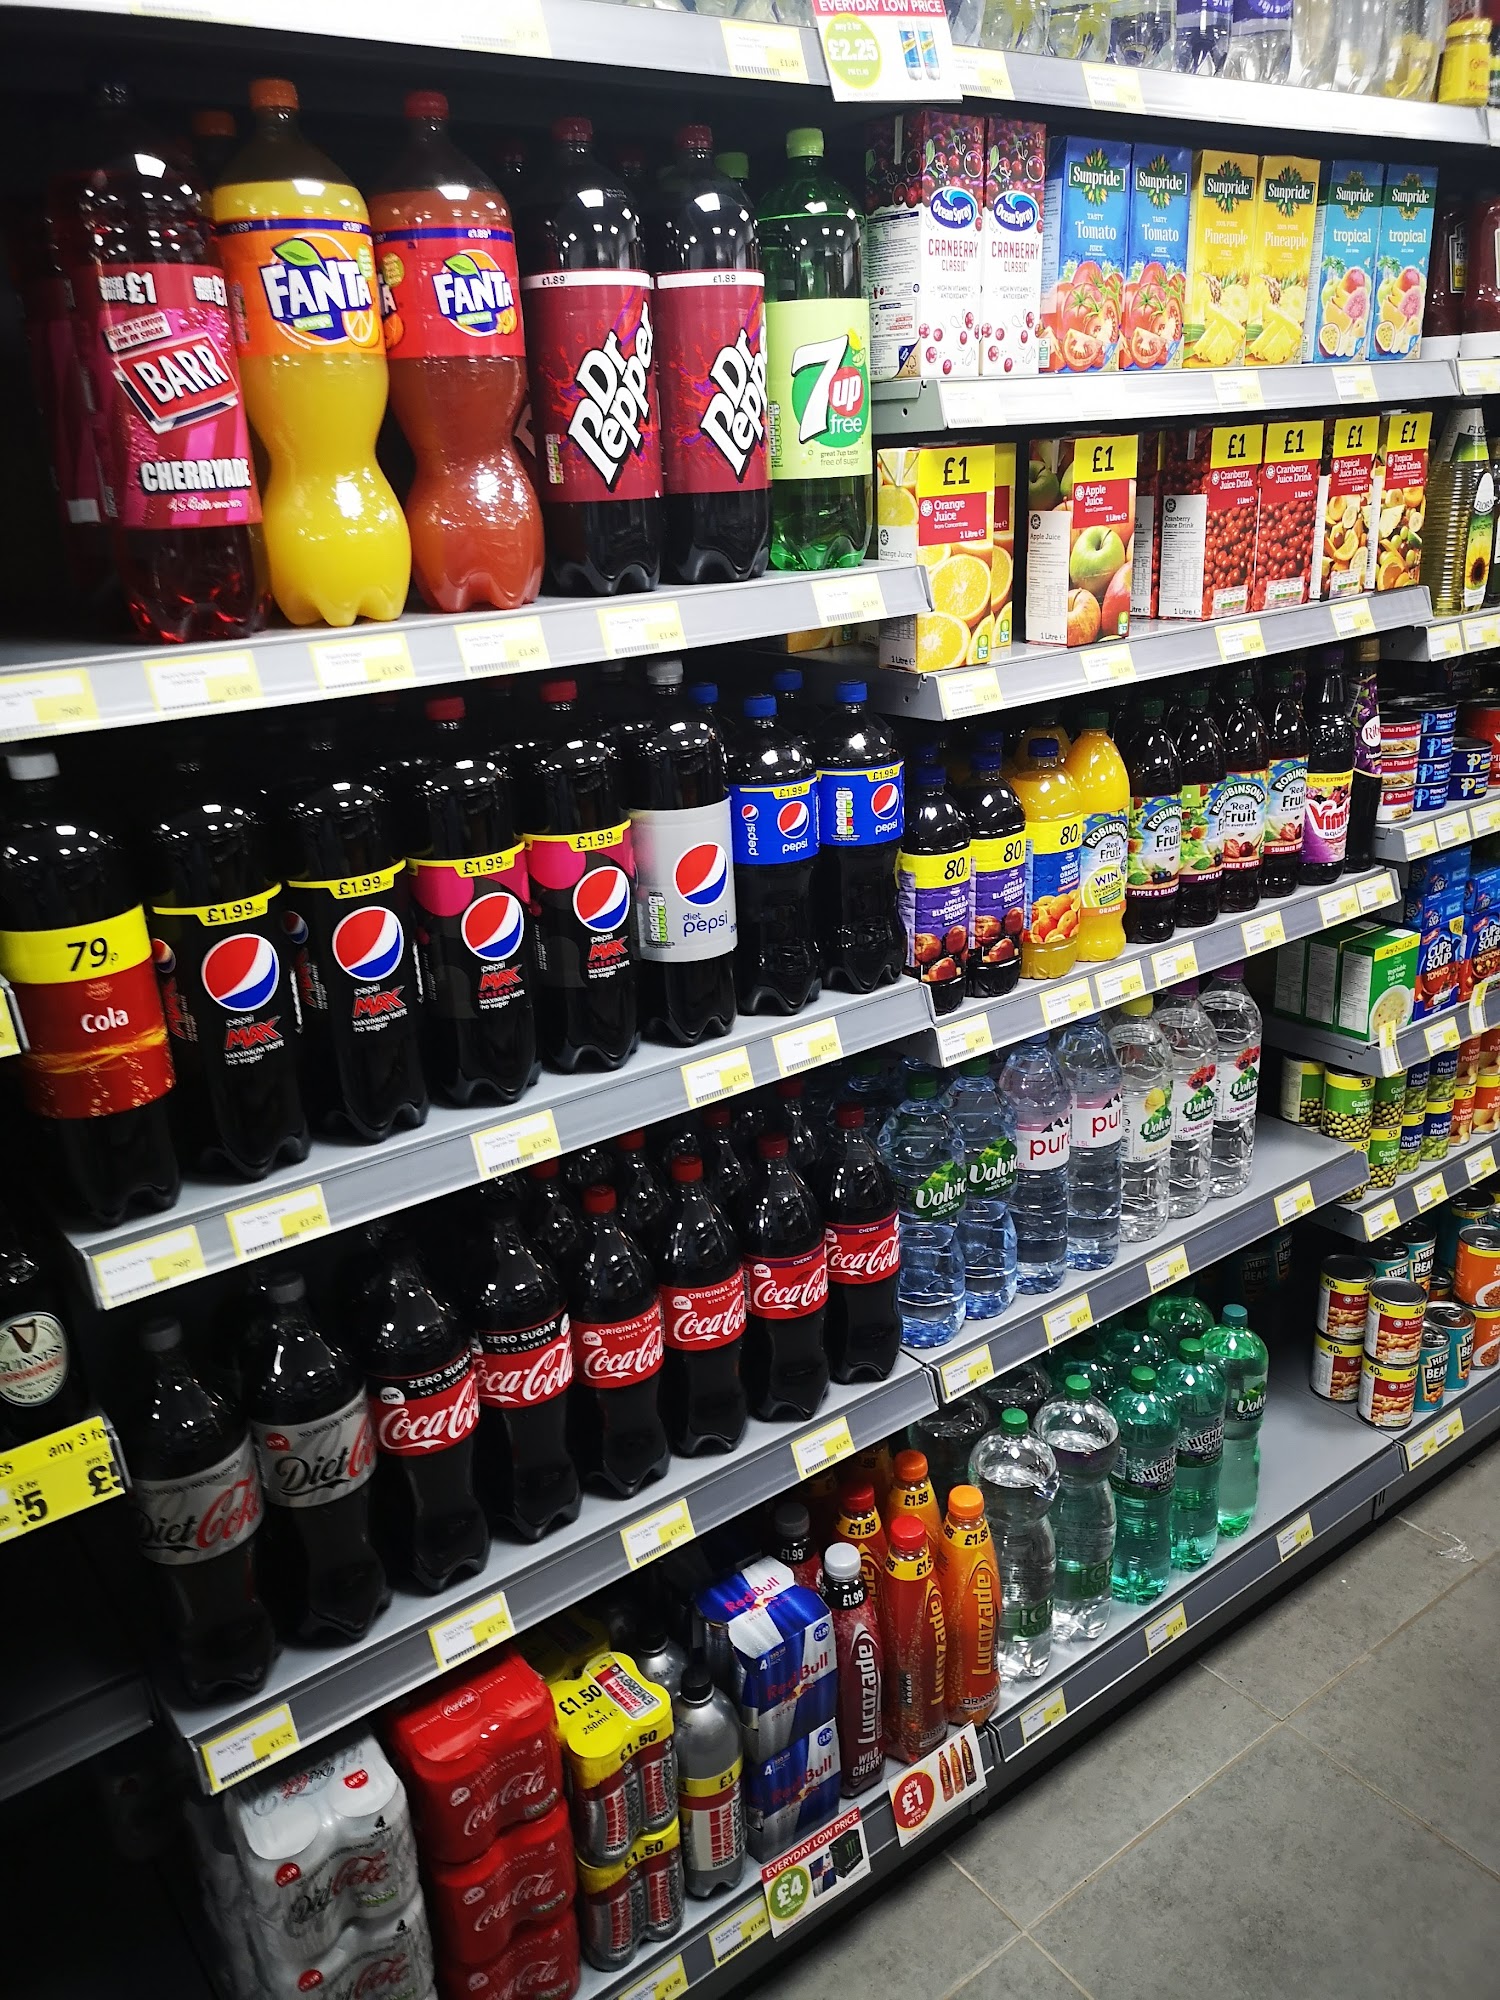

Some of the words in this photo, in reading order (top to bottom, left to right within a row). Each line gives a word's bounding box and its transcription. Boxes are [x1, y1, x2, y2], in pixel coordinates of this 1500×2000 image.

[819, 0, 879, 12] EVERYDAY
[883, 0, 908, 12] LOW
[912, 0, 943, 13] PRICE
[827, 38, 878, 61] £2.25
[1072, 166, 1121, 189] Sunpride
[1139, 171, 1182, 191] Sunpride
[1206, 178, 1250, 199] Sunpride
[1267, 184, 1311, 204] Sunpride
[1335, 186, 1374, 204] Sunpride
[1391, 187, 1430, 205] Sunpride
[933, 199, 954, 222] Ocean
[953, 204, 974, 223] Spray
[995, 203, 1016, 224] Ocean
[1015, 207, 1034, 225] Spray
[1087, 212, 1104, 221] TASTY
[1074, 219, 1117, 240] Tomato
[1141, 223, 1180, 242] Tomato
[1204, 229, 1249, 246] Pineapple
[1333, 229, 1371, 243] tropical
[1389, 228, 1427, 244] tropical
[928, 238, 978, 259] CRANBERRY
[991, 240, 1039, 260] CRANBERRY
[1264, 232, 1309, 249] Pineapple
[941, 259, 966, 273] CLASSIC
[1004, 260, 1029, 273] CLASSIC
[125, 271, 157, 304] £1
[541, 274, 566, 286] £1.89
[712, 274, 737, 284] £1.89
[261, 261, 373, 318] FANTA
[435, 271, 514, 315] FANTA
[133, 344, 229, 404] BARR
[576, 331, 628, 416] Dr
[710, 328, 757, 410] Dr
[568, 301, 653, 486] Pepper
[829, 415, 862, 435] free
[1400, 420, 1417, 444] £1
[1227, 432, 1247, 459] £1
[1284, 428, 1305, 454] £1
[1347, 424, 1363, 449] £1
[820, 458, 834, 467] free
[835, 457, 843, 465] of
[843, 456, 860, 467] sugar
[1092, 445, 1115, 473] £1
[1339, 459, 1360, 471] Tropical
[1394, 453, 1414, 465] Tropical
[1394, 462, 1408, 472] Juice
[1407, 460, 1422, 470] Drink
[139, 459, 252, 492] CHERRYADE
[942, 456, 971, 486] £1
[1220, 470, 1250, 483] Cranberry
[1275, 463, 1309, 476] Cranberry
[1275, 473, 1293, 485] Juice
[1293, 471, 1313, 483] Drink
[1339, 468, 1353, 478] Juice
[1353, 466, 1368, 476] Drink
[1085, 484, 1107, 496] Apple
[1219, 479, 1235, 490] Juice
[1236, 477, 1253, 488] Drink
[933, 499, 965, 511] Orange
[1084, 496, 1104, 506] Juice
[1475, 499, 1495, 512] FLORA
[933, 511, 957, 523] Juice
[964, 530, 978, 538] Litre
[1029, 532, 1045, 542] Apple
[1046, 532, 1061, 541] Juice
[880, 549, 898, 559] Orange
[898, 549, 913, 559] Juice
[1045, 631, 1059, 641] Litre
[895, 655, 909, 665] Litre
[1395, 725, 1411, 734] Flakes
[872, 768, 894, 781] £1.99
[778, 785, 804, 799] £1.99
[1230, 801, 1253, 811] Real
[1225, 809, 1257, 823] Fruit
[875, 818, 898, 836] pepsi
[575, 830, 614, 850] £1.99
[748, 822, 759, 857] pepsi
[781, 838, 809, 855] pepsi
[1270, 845, 1294, 853] SUMMER
[1099, 847, 1121, 861] Fruit
[462, 855, 504, 876] £1.99
[1241, 860, 1260, 869] FRUITS
[337, 875, 382, 897] £1.99
[1094, 871, 1119, 887] WIN
[206, 901, 254, 923] £1.99
[682, 911, 702, 922] diet
[1098, 905, 1121, 915] ORANGE
[683, 910, 729, 938] pepsi
[588, 935, 629, 961] MAX
[1425, 952, 1452, 971] SOUP
[478, 963, 523, 992] MAX
[1426, 966, 1450, 981] TOMATO
[352, 984, 406, 1018] MAX
[80, 1006, 130, 1034] Cola
[225, 1015, 255, 1028] pepsi
[224, 1015, 282, 1051] MAX
[968, 1153, 1018, 1185] Volvic
[915, 1176, 968, 1209] Volvic
[858, 1226, 880, 1235] CHERRY
[793, 1255, 813, 1265] CHERRY
[688, 1285, 730, 1299] ORIGINAL
[754, 1263, 827, 1310] Coca-Cola
[673, 1291, 746, 1342] Coca-Cola
[487, 1331, 518, 1345] ZERO
[520, 1321, 557, 1341] SUGAR
[598, 1322, 642, 1336] ORIGINAL
[584, 1326, 663, 1380] Coca-Cola
[408, 1370, 442, 1389] ZERO
[274, 1445, 352, 1491] Diet
[903, 1491, 930, 1507] £1.99
[847, 1518, 878, 1536] £1.99
[963, 1528, 990, 1547] £1.99
[723, 1590, 755, 1613] Red
[752, 1576, 781, 1598] Bull
[842, 1590, 865, 1607] £1.99
[971, 1573, 993, 1676] Lucozade
[800, 1651, 829, 1681] Bull
[559, 1683, 603, 1716] £1.50
[856, 1642, 881, 1745] Lucozade
[582, 1714, 610, 1736] 250ml
[620, 1729, 658, 1763] £1.50
[857, 1746, 879, 1765] WILD
[852, 1755, 882, 1777] CHERRY
[904, 1779, 919, 1793] only
[902, 1785, 924, 1816] £1
[722, 1803, 734, 1857] ORIGINAL
[765, 1842, 813, 1879] EVERYDAY
[812, 1829, 834, 1850] LOW
[834, 1811, 859, 1834] PRICE
[624, 1840, 664, 1870] £1.50
[776, 1874, 804, 1909] £4
